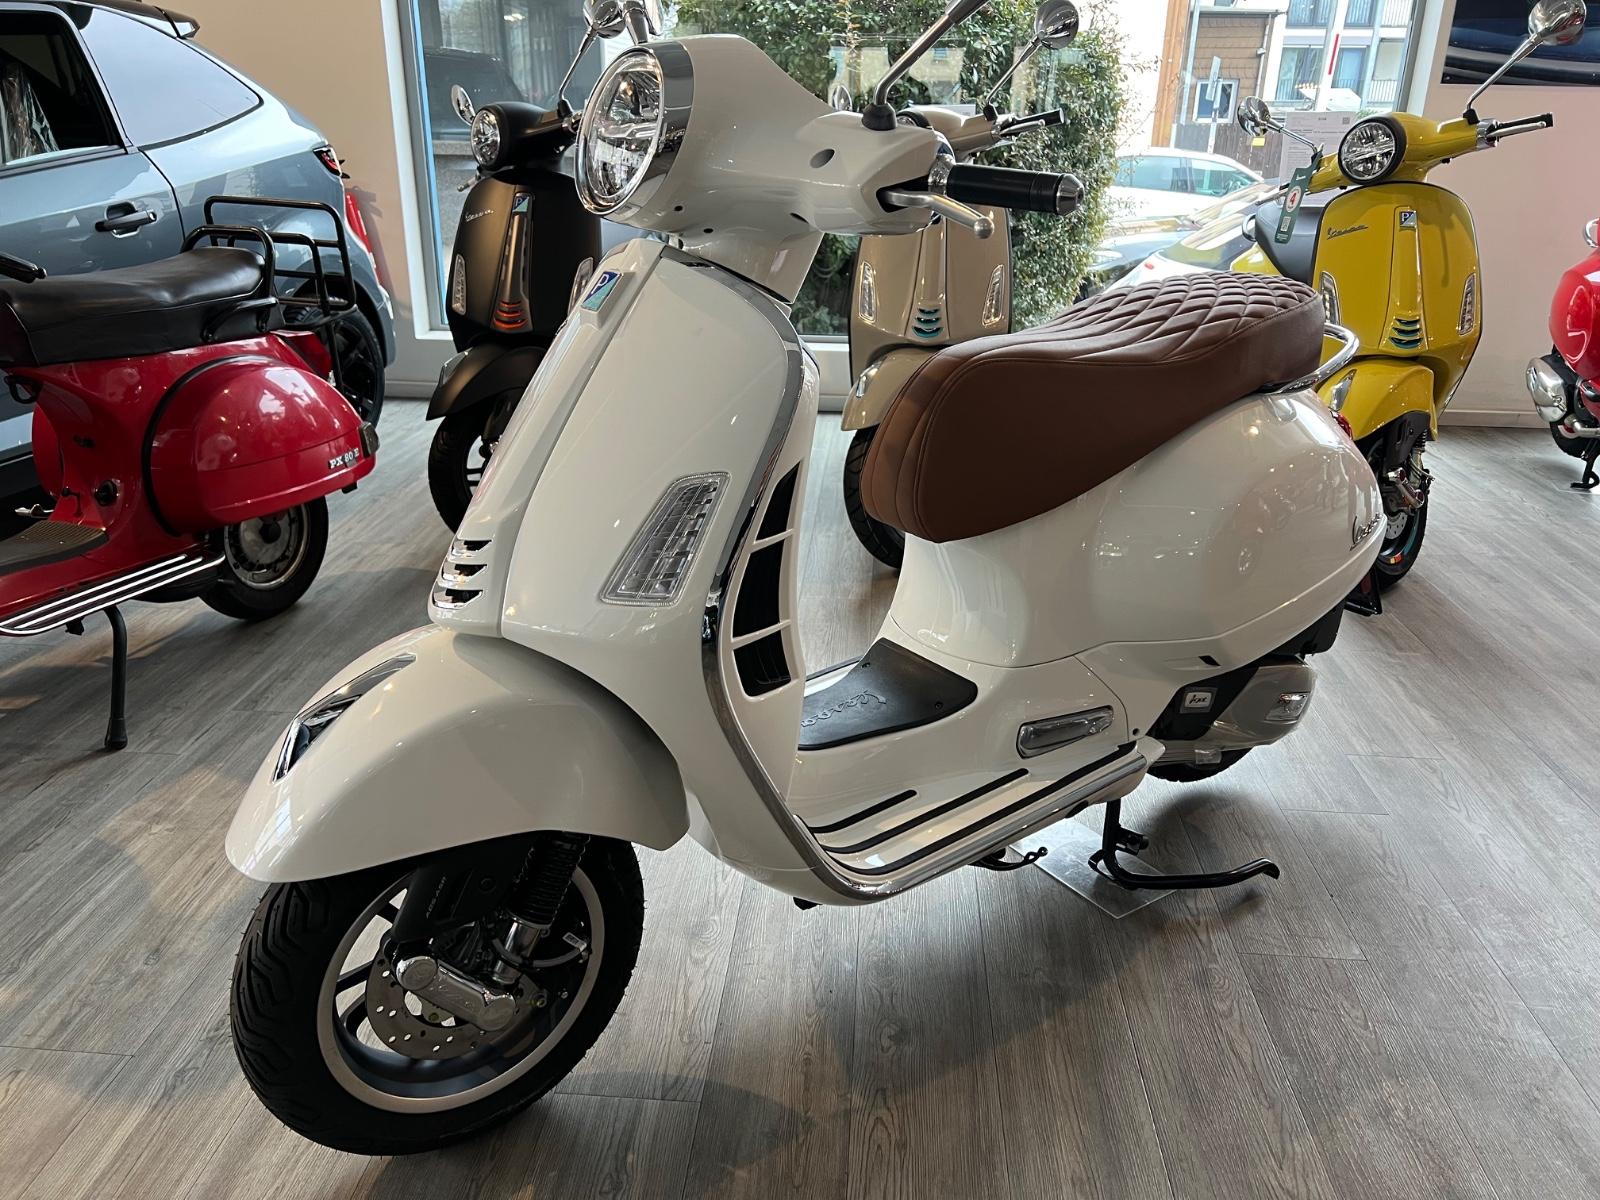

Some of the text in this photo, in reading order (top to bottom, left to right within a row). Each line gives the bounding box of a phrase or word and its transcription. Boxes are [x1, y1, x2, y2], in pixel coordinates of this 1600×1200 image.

[590, 273, 610, 295] P
[329, 455, 344, 469] PX
[344, 450, 354, 463] 80
